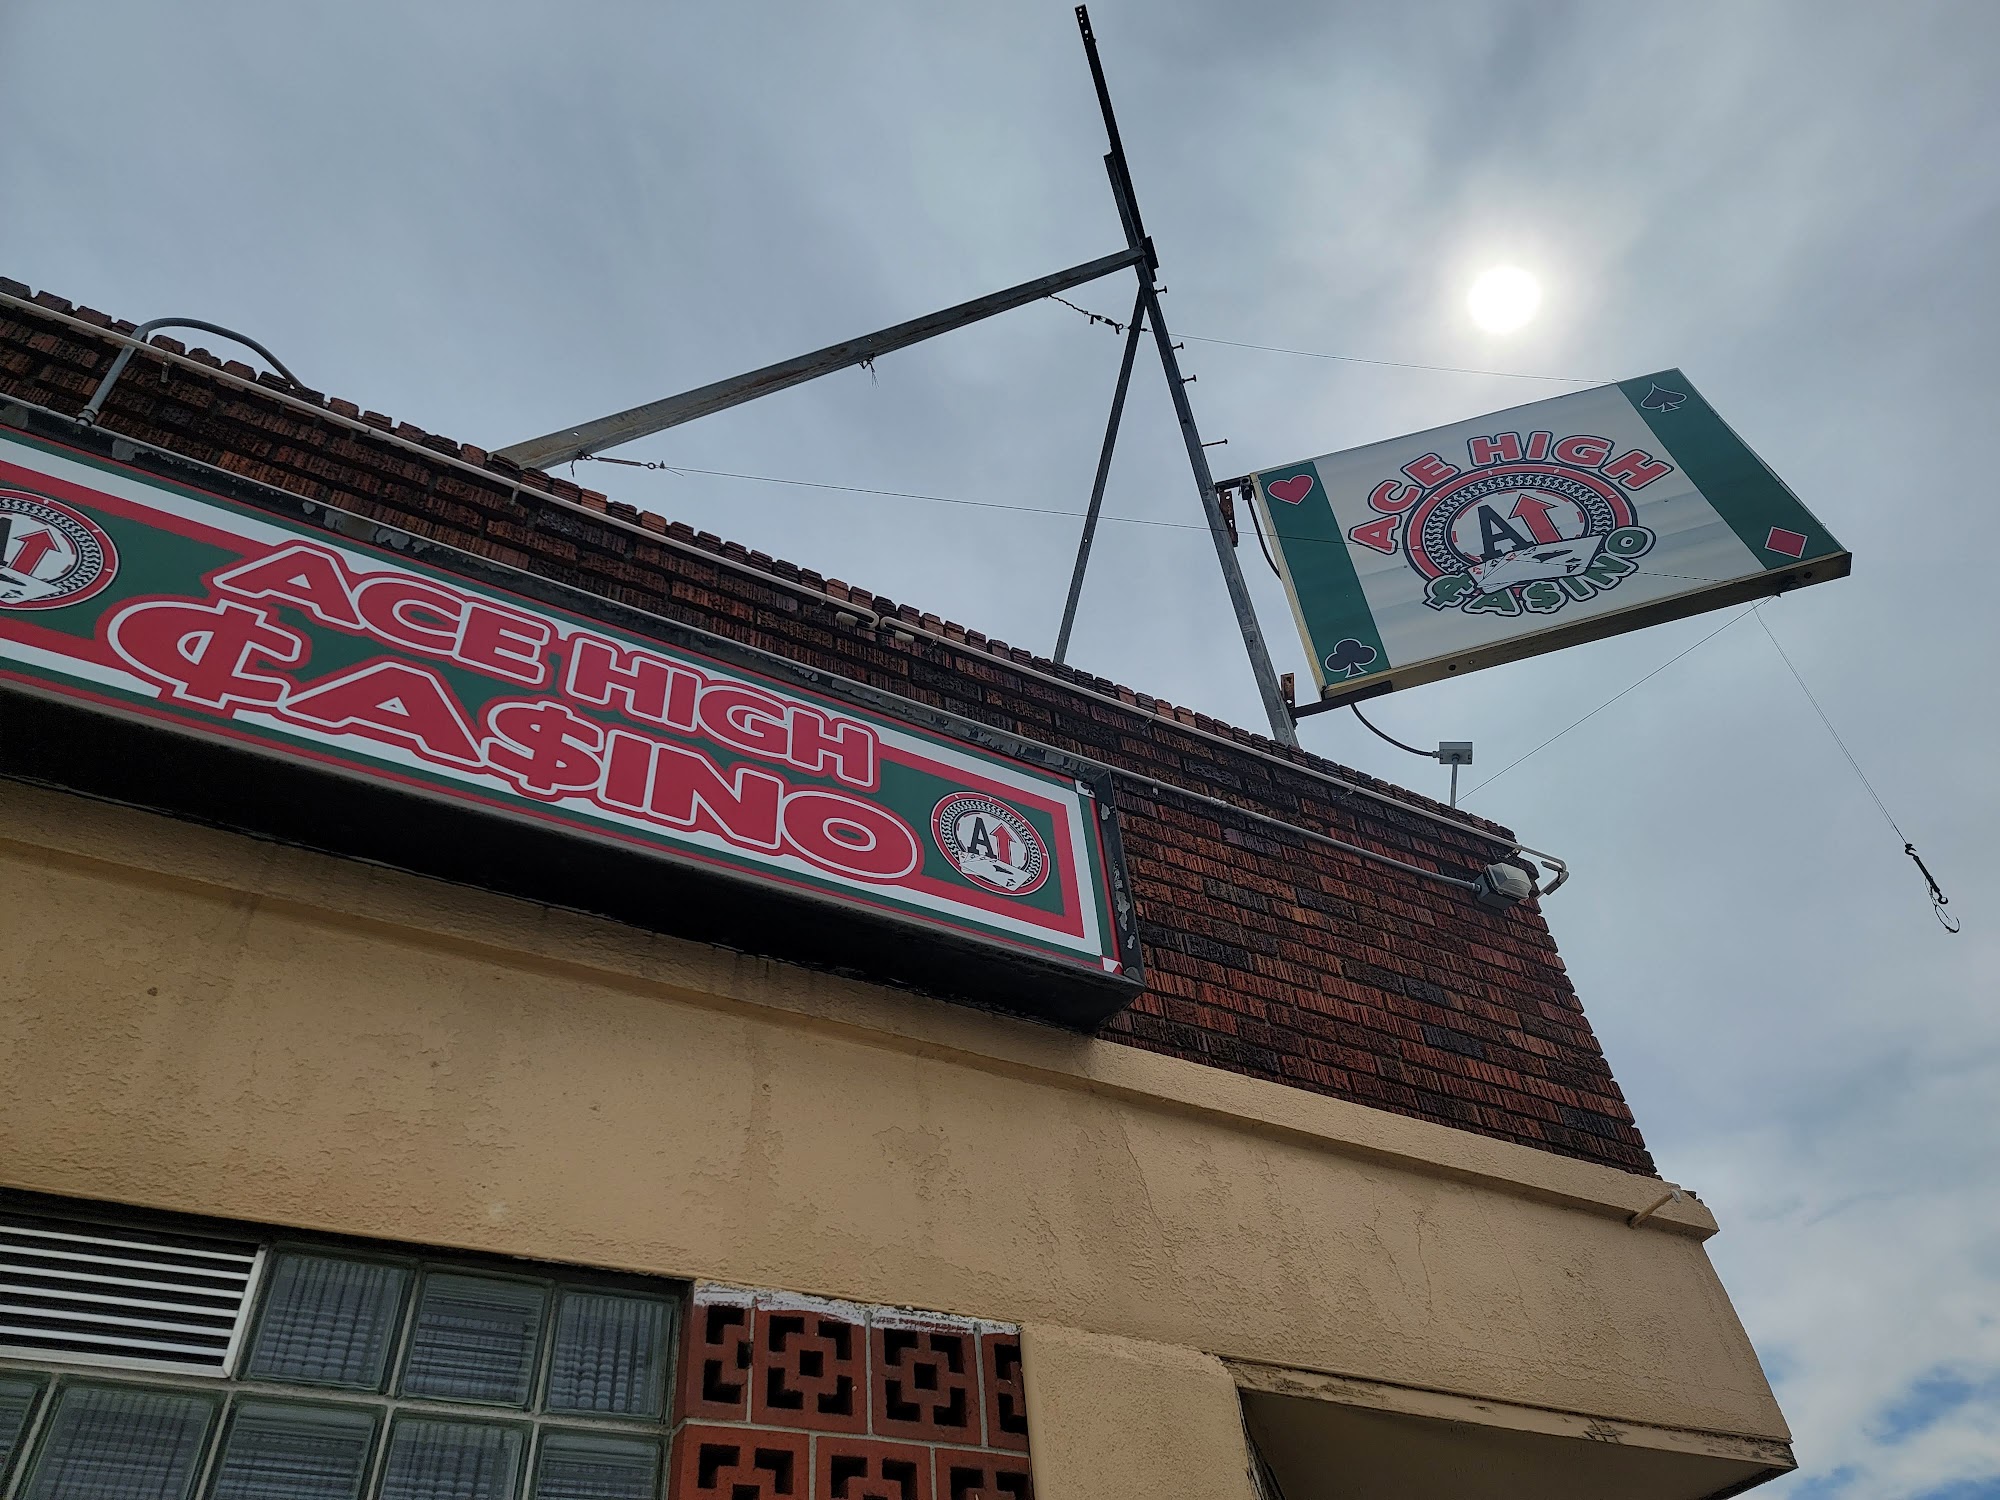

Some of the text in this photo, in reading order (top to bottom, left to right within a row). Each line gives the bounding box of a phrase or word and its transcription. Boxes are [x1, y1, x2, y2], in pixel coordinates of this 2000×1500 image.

[1349, 432, 1673, 554] ACE HIGH
[211, 544, 880, 788] ACE HIGH
